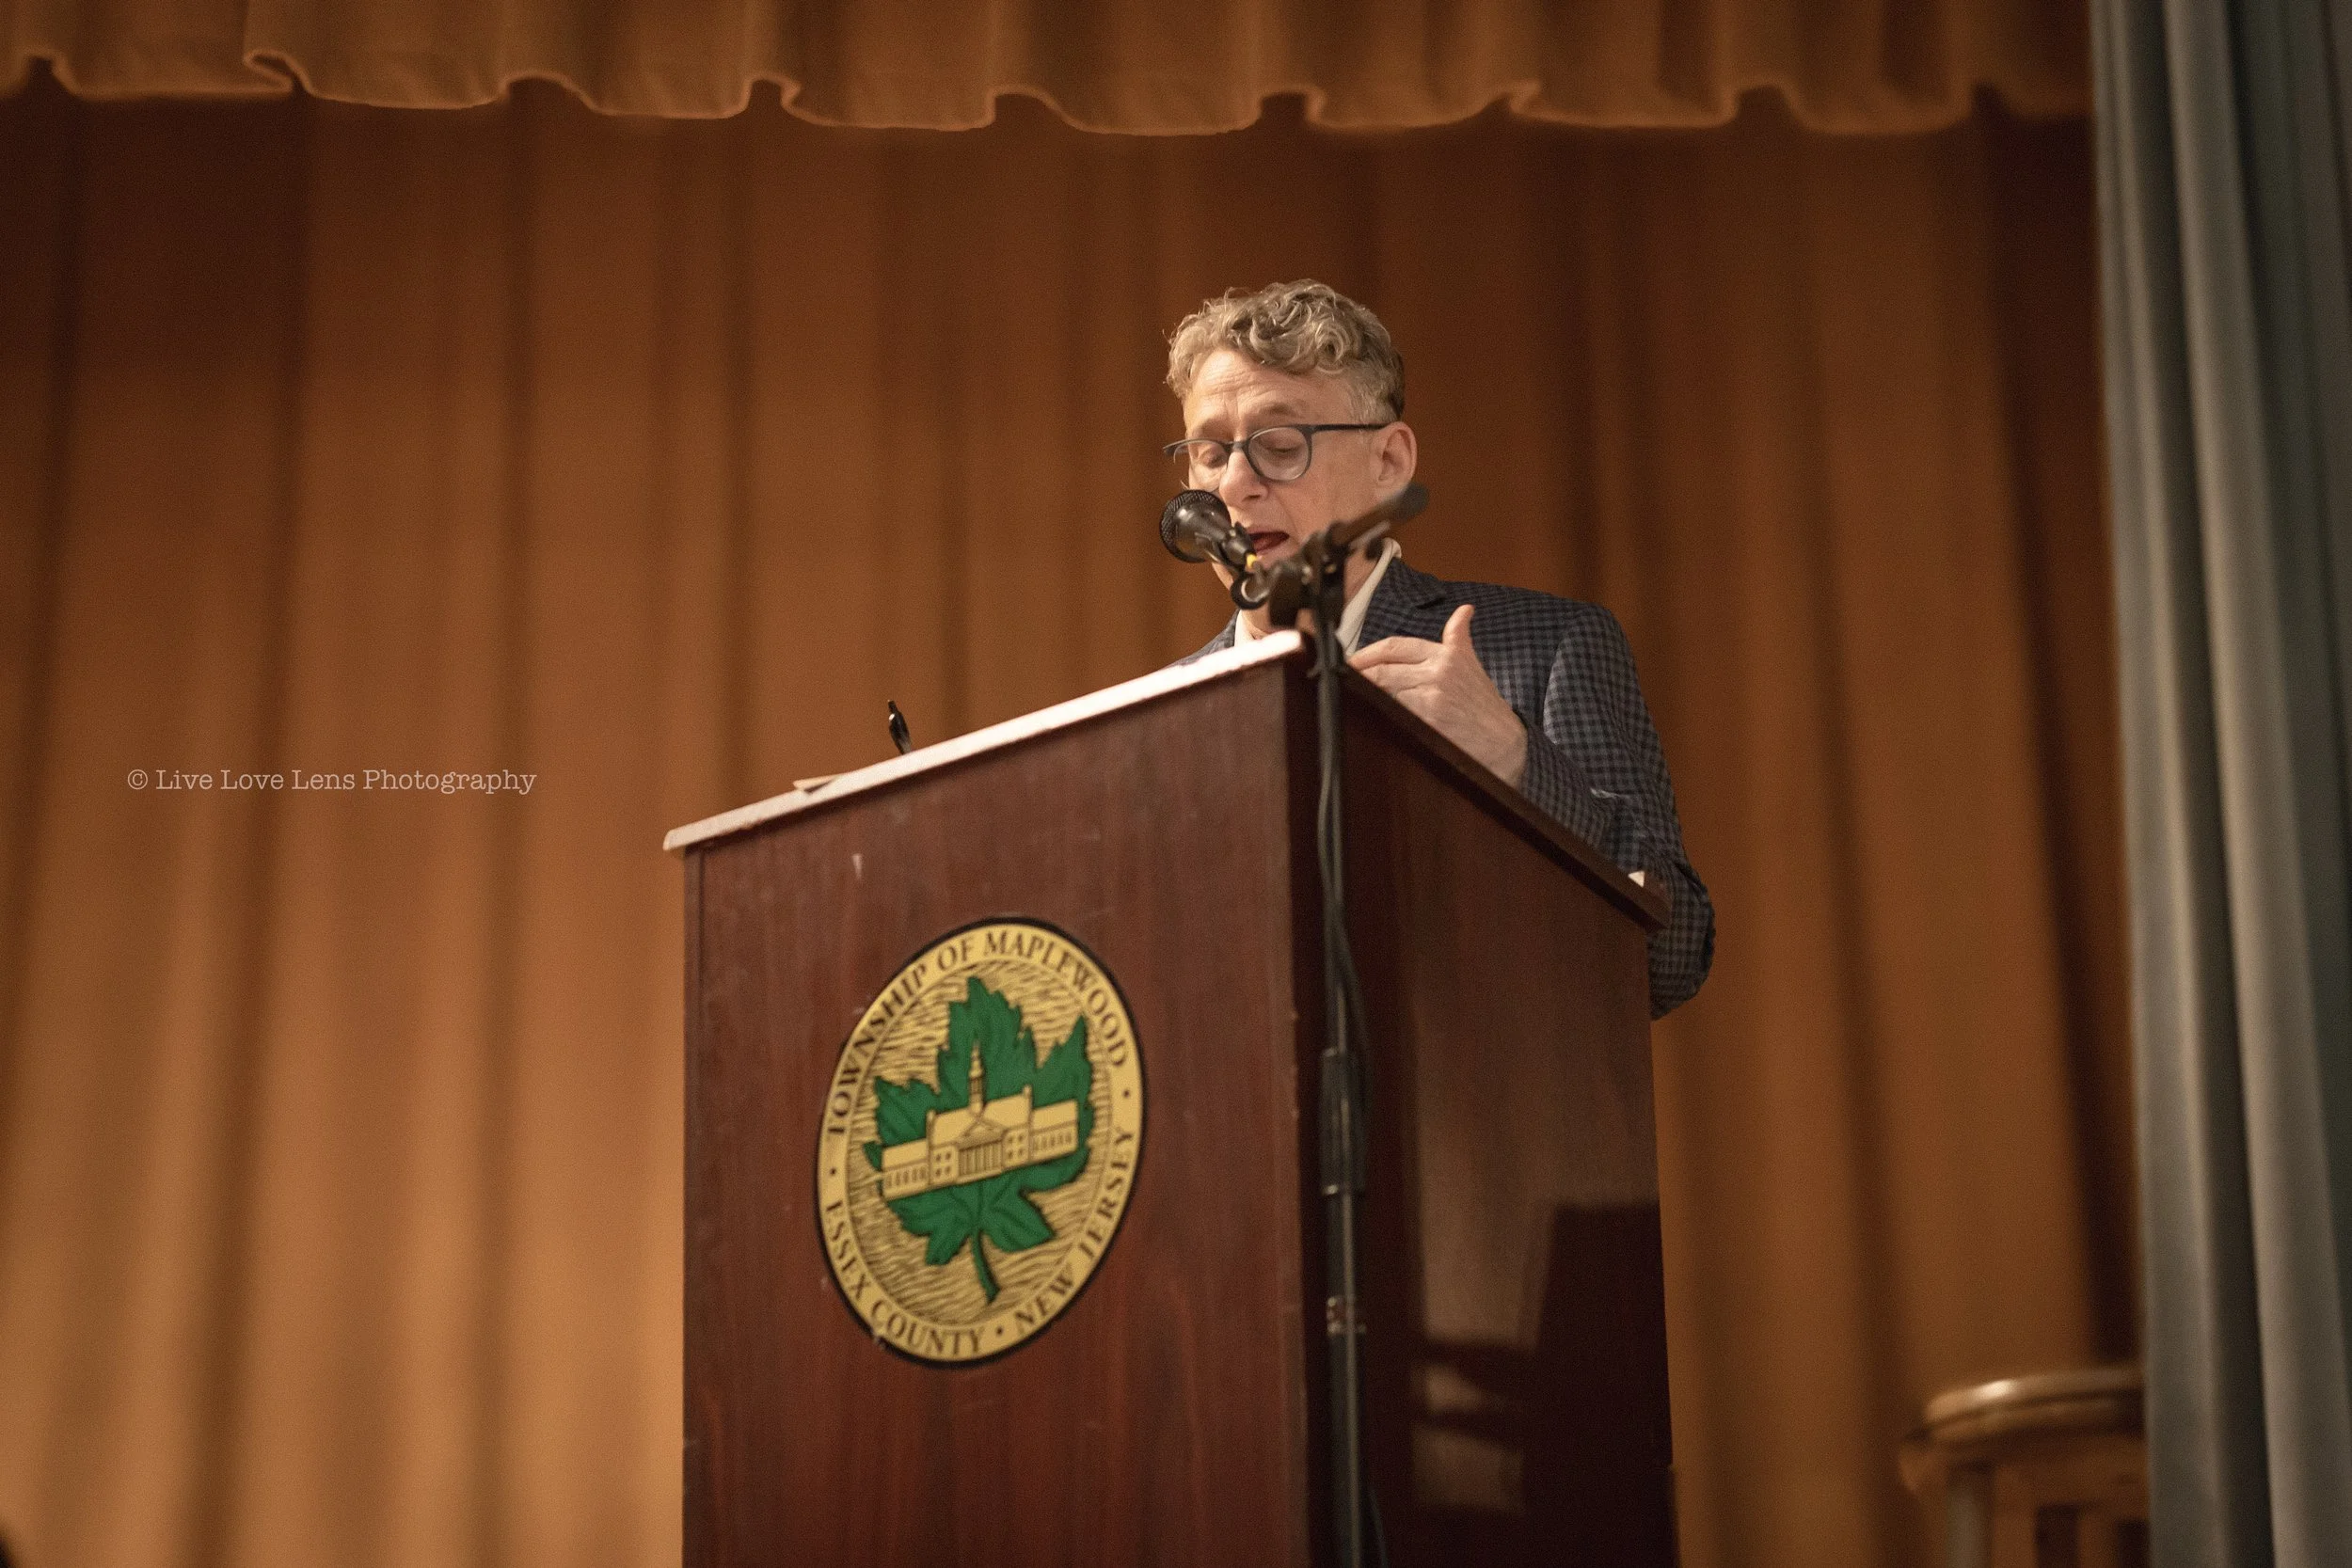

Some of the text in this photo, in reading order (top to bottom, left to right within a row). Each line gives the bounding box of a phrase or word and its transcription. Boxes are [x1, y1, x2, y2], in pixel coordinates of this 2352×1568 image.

[828, 928, 1127, 1136] TOWNSHIP OF MAPLEWOOD
[825, 1128, 1135, 1355] ESSEX COUNTY NEW JERSEY
